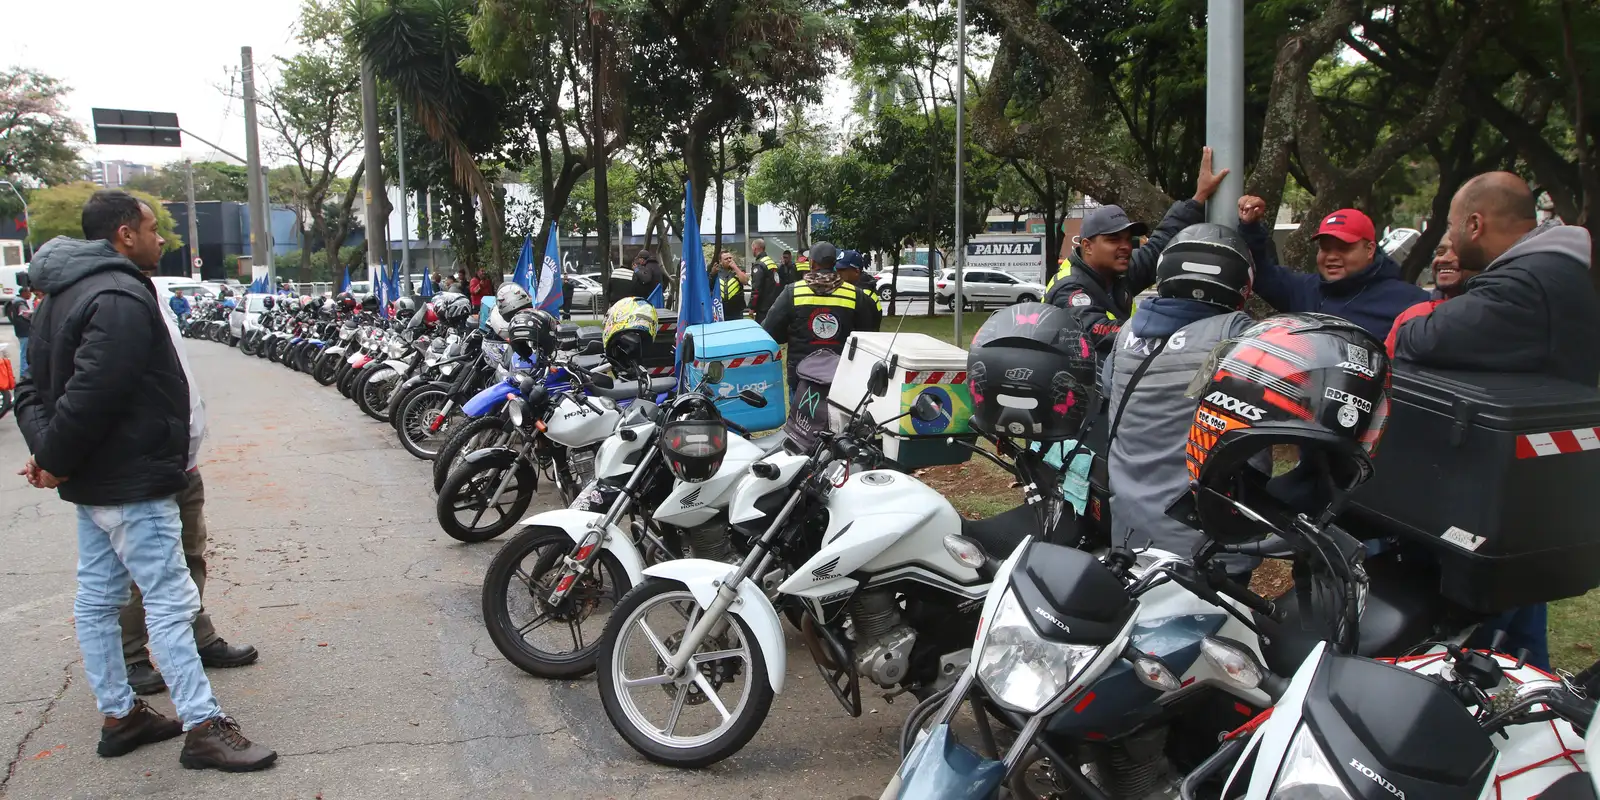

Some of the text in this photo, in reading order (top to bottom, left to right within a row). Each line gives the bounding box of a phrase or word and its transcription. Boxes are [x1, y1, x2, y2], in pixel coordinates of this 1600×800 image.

[974, 243, 1034, 255] PANNAN
[1334, 361, 1375, 378] AXXIS
[736, 380, 768, 394] Loggi
[1204, 391, 1267, 420] AXXIS
[1327, 388, 1371, 412] RDG 9060
[1211, 417, 1226, 430] 9060
[680, 501, 704, 510] HONDA
[812, 573, 842, 581] HONDA
[1034, 606, 1071, 634] HONDA
[1348, 757, 1406, 800] HONDA
